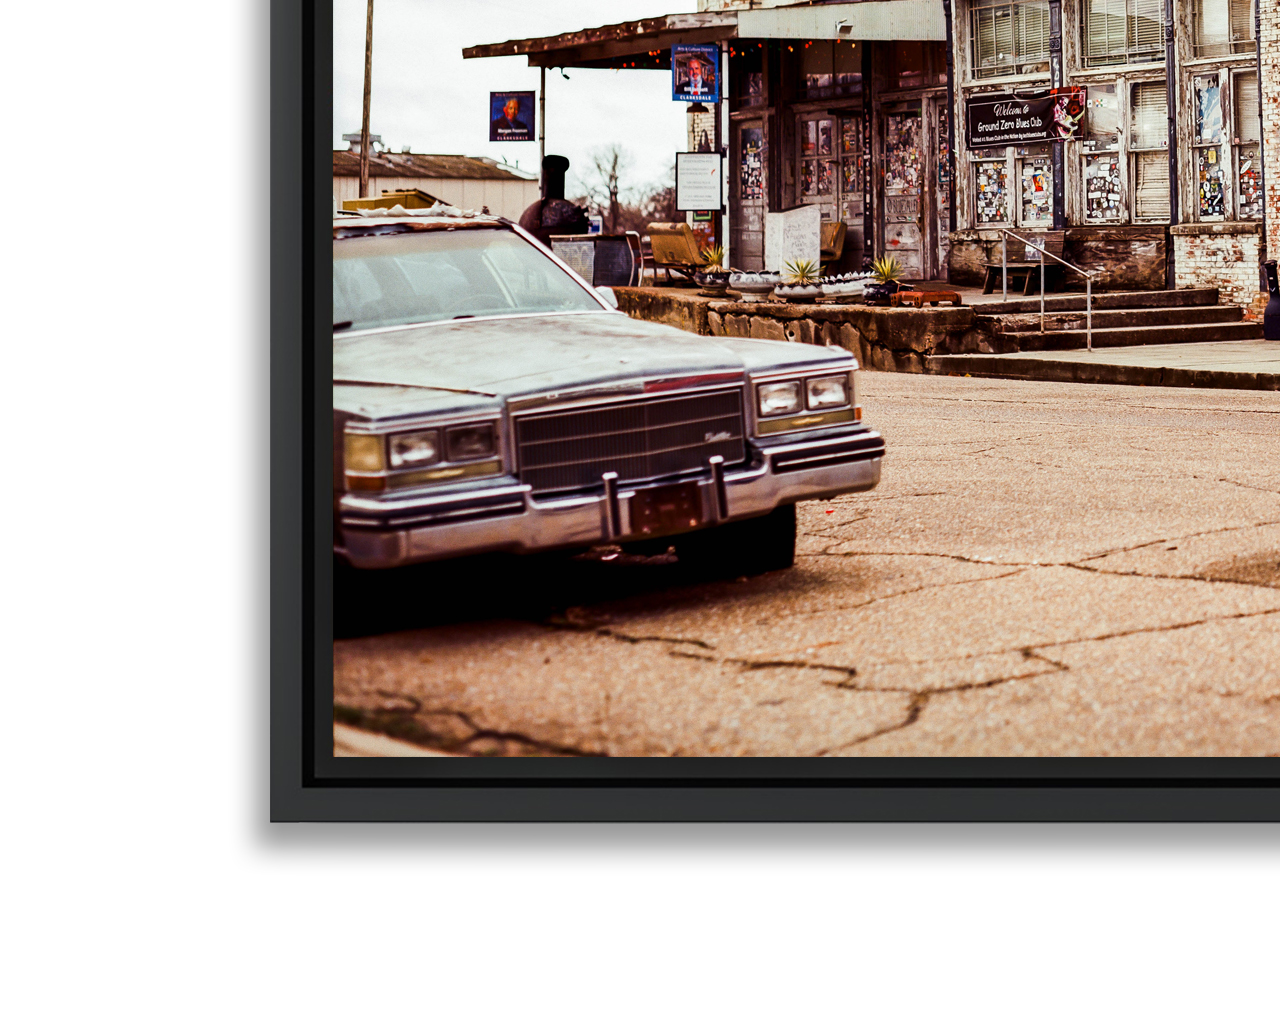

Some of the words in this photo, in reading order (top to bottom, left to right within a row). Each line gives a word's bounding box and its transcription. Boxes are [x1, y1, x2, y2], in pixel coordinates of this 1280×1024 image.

[978, 120, 999, 132] Ground
[1000, 119, 1014, 130] Zero
[1016, 118, 1030, 128] Blues
[1030, 116, 1042, 128] Club
